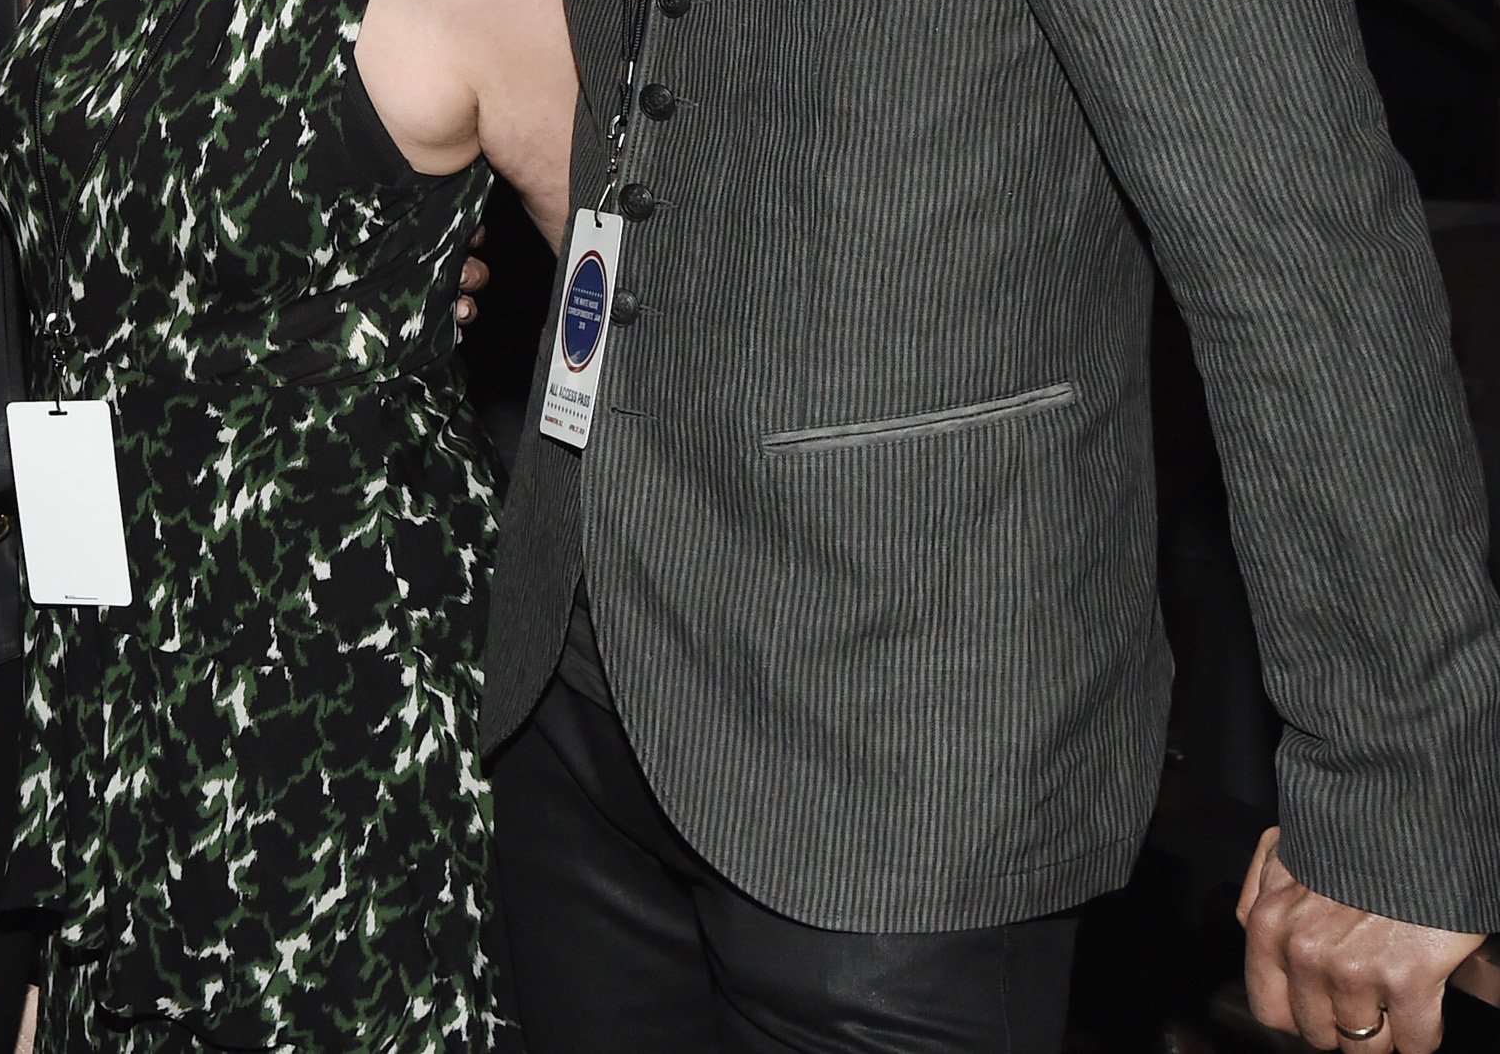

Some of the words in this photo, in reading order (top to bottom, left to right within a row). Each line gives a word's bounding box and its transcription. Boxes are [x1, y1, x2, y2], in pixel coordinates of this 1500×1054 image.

[550, 383, 558, 396] ALL
[559, 386, 577, 403] ACCESS
[578, 392, 591, 408] PASS
